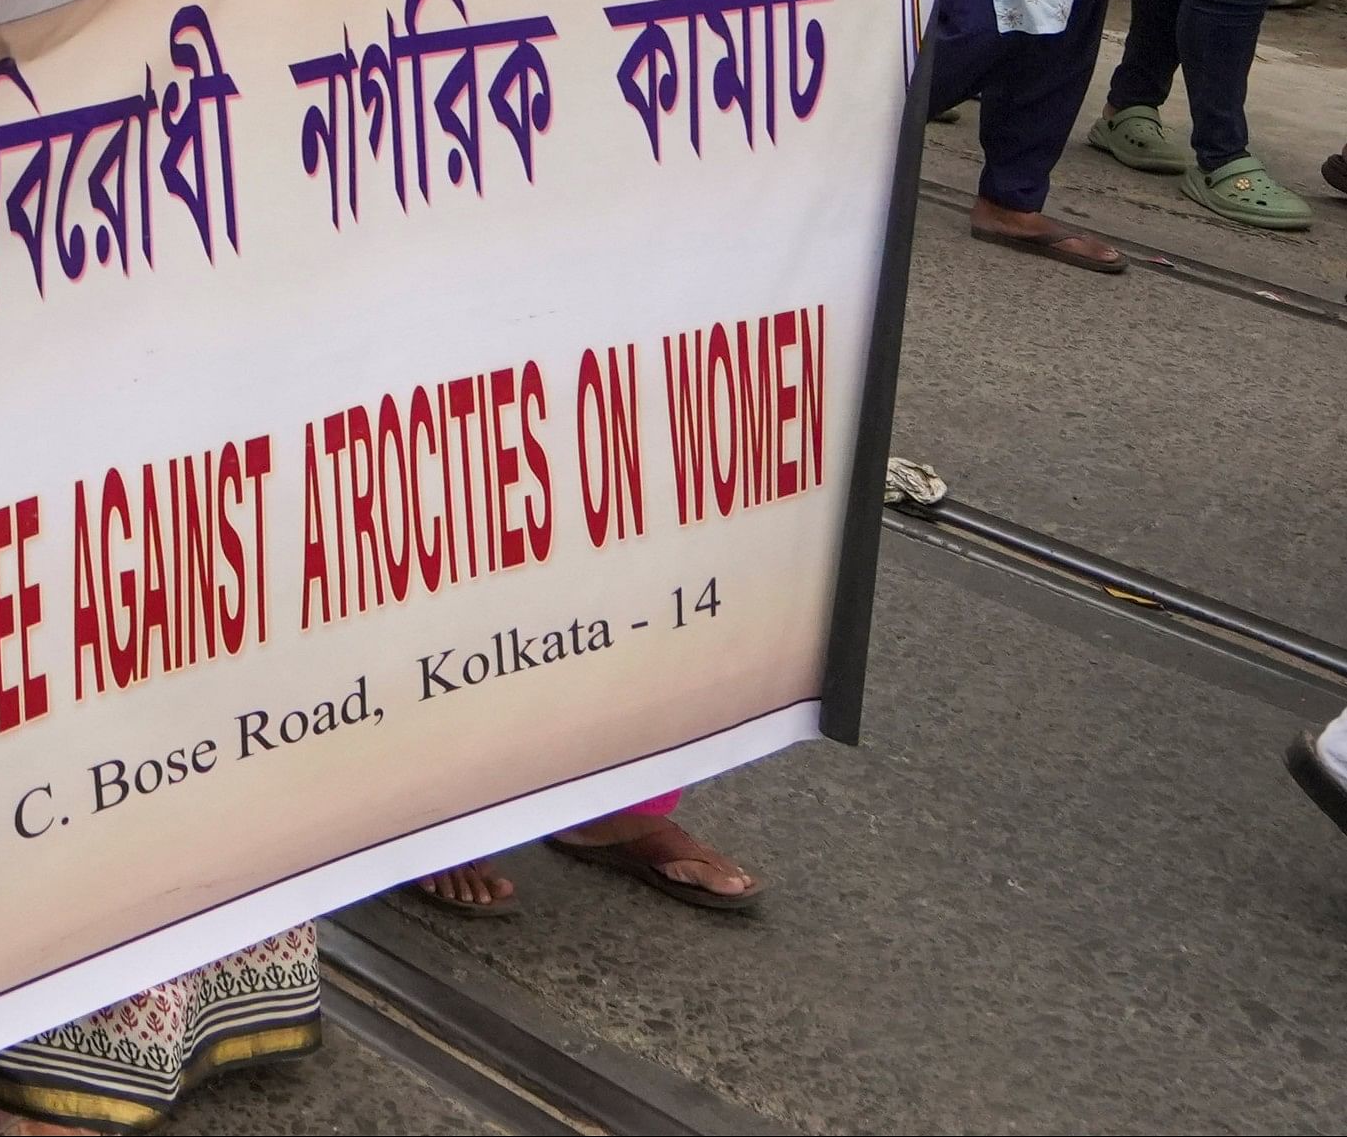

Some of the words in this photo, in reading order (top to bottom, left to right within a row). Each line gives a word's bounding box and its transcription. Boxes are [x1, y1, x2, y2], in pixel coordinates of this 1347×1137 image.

[73, 435, 271, 701] AGAINST
[301, 360, 553, 631] ATROCITIES
[576, 343, 645, 548] ON
[662, 304, 825, 525] WOMEN
[13, 782, 70, 839] C.
[89, 732, 218, 815] Bose
[236, 676, 386, 761] Road,
[416, 613, 613, 702] Kolkata
[670, 576, 722, 632] 14
